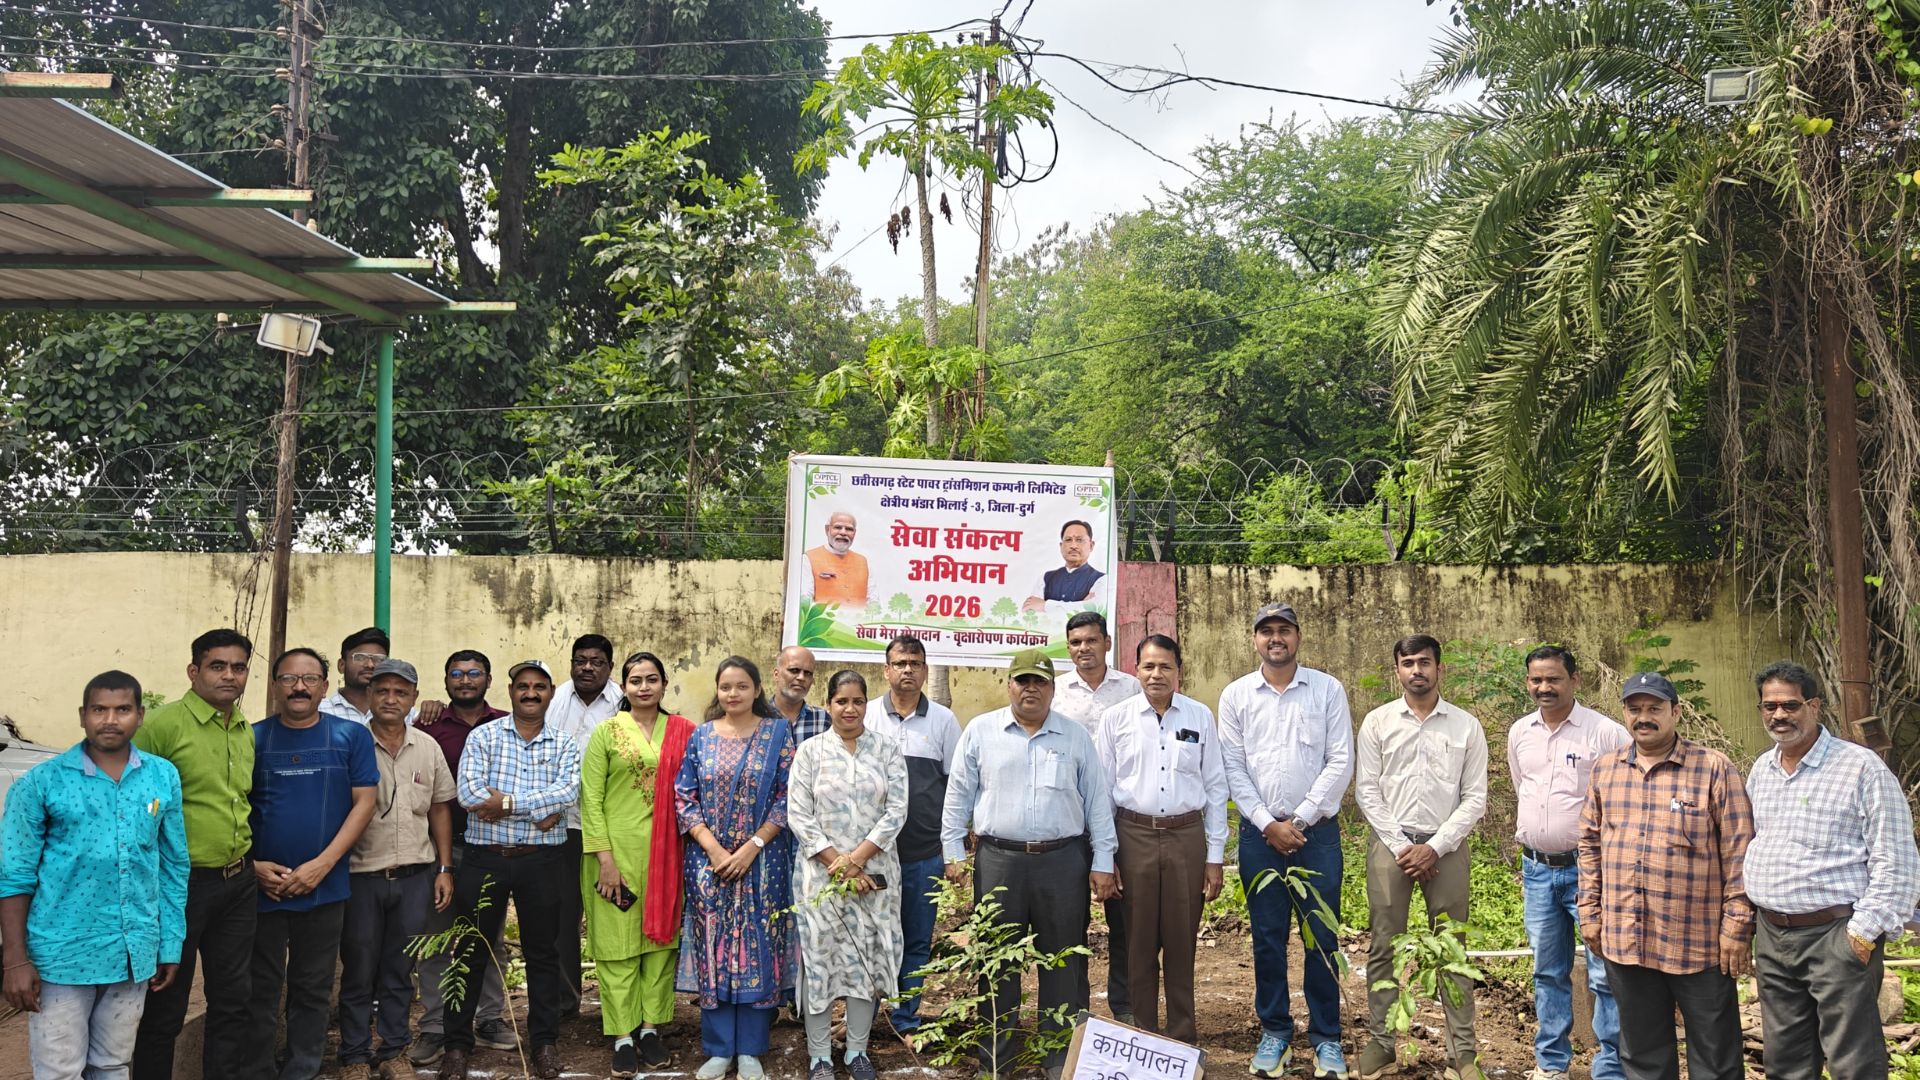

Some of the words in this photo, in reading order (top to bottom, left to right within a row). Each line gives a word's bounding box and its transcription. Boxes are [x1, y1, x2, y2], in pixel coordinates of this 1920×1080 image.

[852, 474, 895, 490] छत्तीसगढ़
[897, 475, 915, 488] स्टेट
[917, 479, 940, 490] पावर
[942, 478, 989, 493] ट्रांसमिशन
[992, 480, 1026, 493] कम्पनी
[1028, 481, 1067, 495] लिमिटेड
[880, 495, 909, 508] क्षेत्रीय
[911, 496, 935, 509] भंडार
[937, 497, 968, 512] भिलाई
[988, 499, 1036, 516] जिला-दुर्ग
[890, 519, 939, 548] सेवा
[943, 523, 1023, 552] संकल्प
[908, 555, 1008, 584] अभियान
[925, 594, 981, 618] 2026
[856, 624, 877, 639] सेवा
[879, 625, 898, 639] मेरा
[953, 629, 1003, 646] वृक्षारोपण
[1006, 630, 1049, 646] कार्यक्रम
[1093, 1033, 1188, 1078] कार्यपालन
